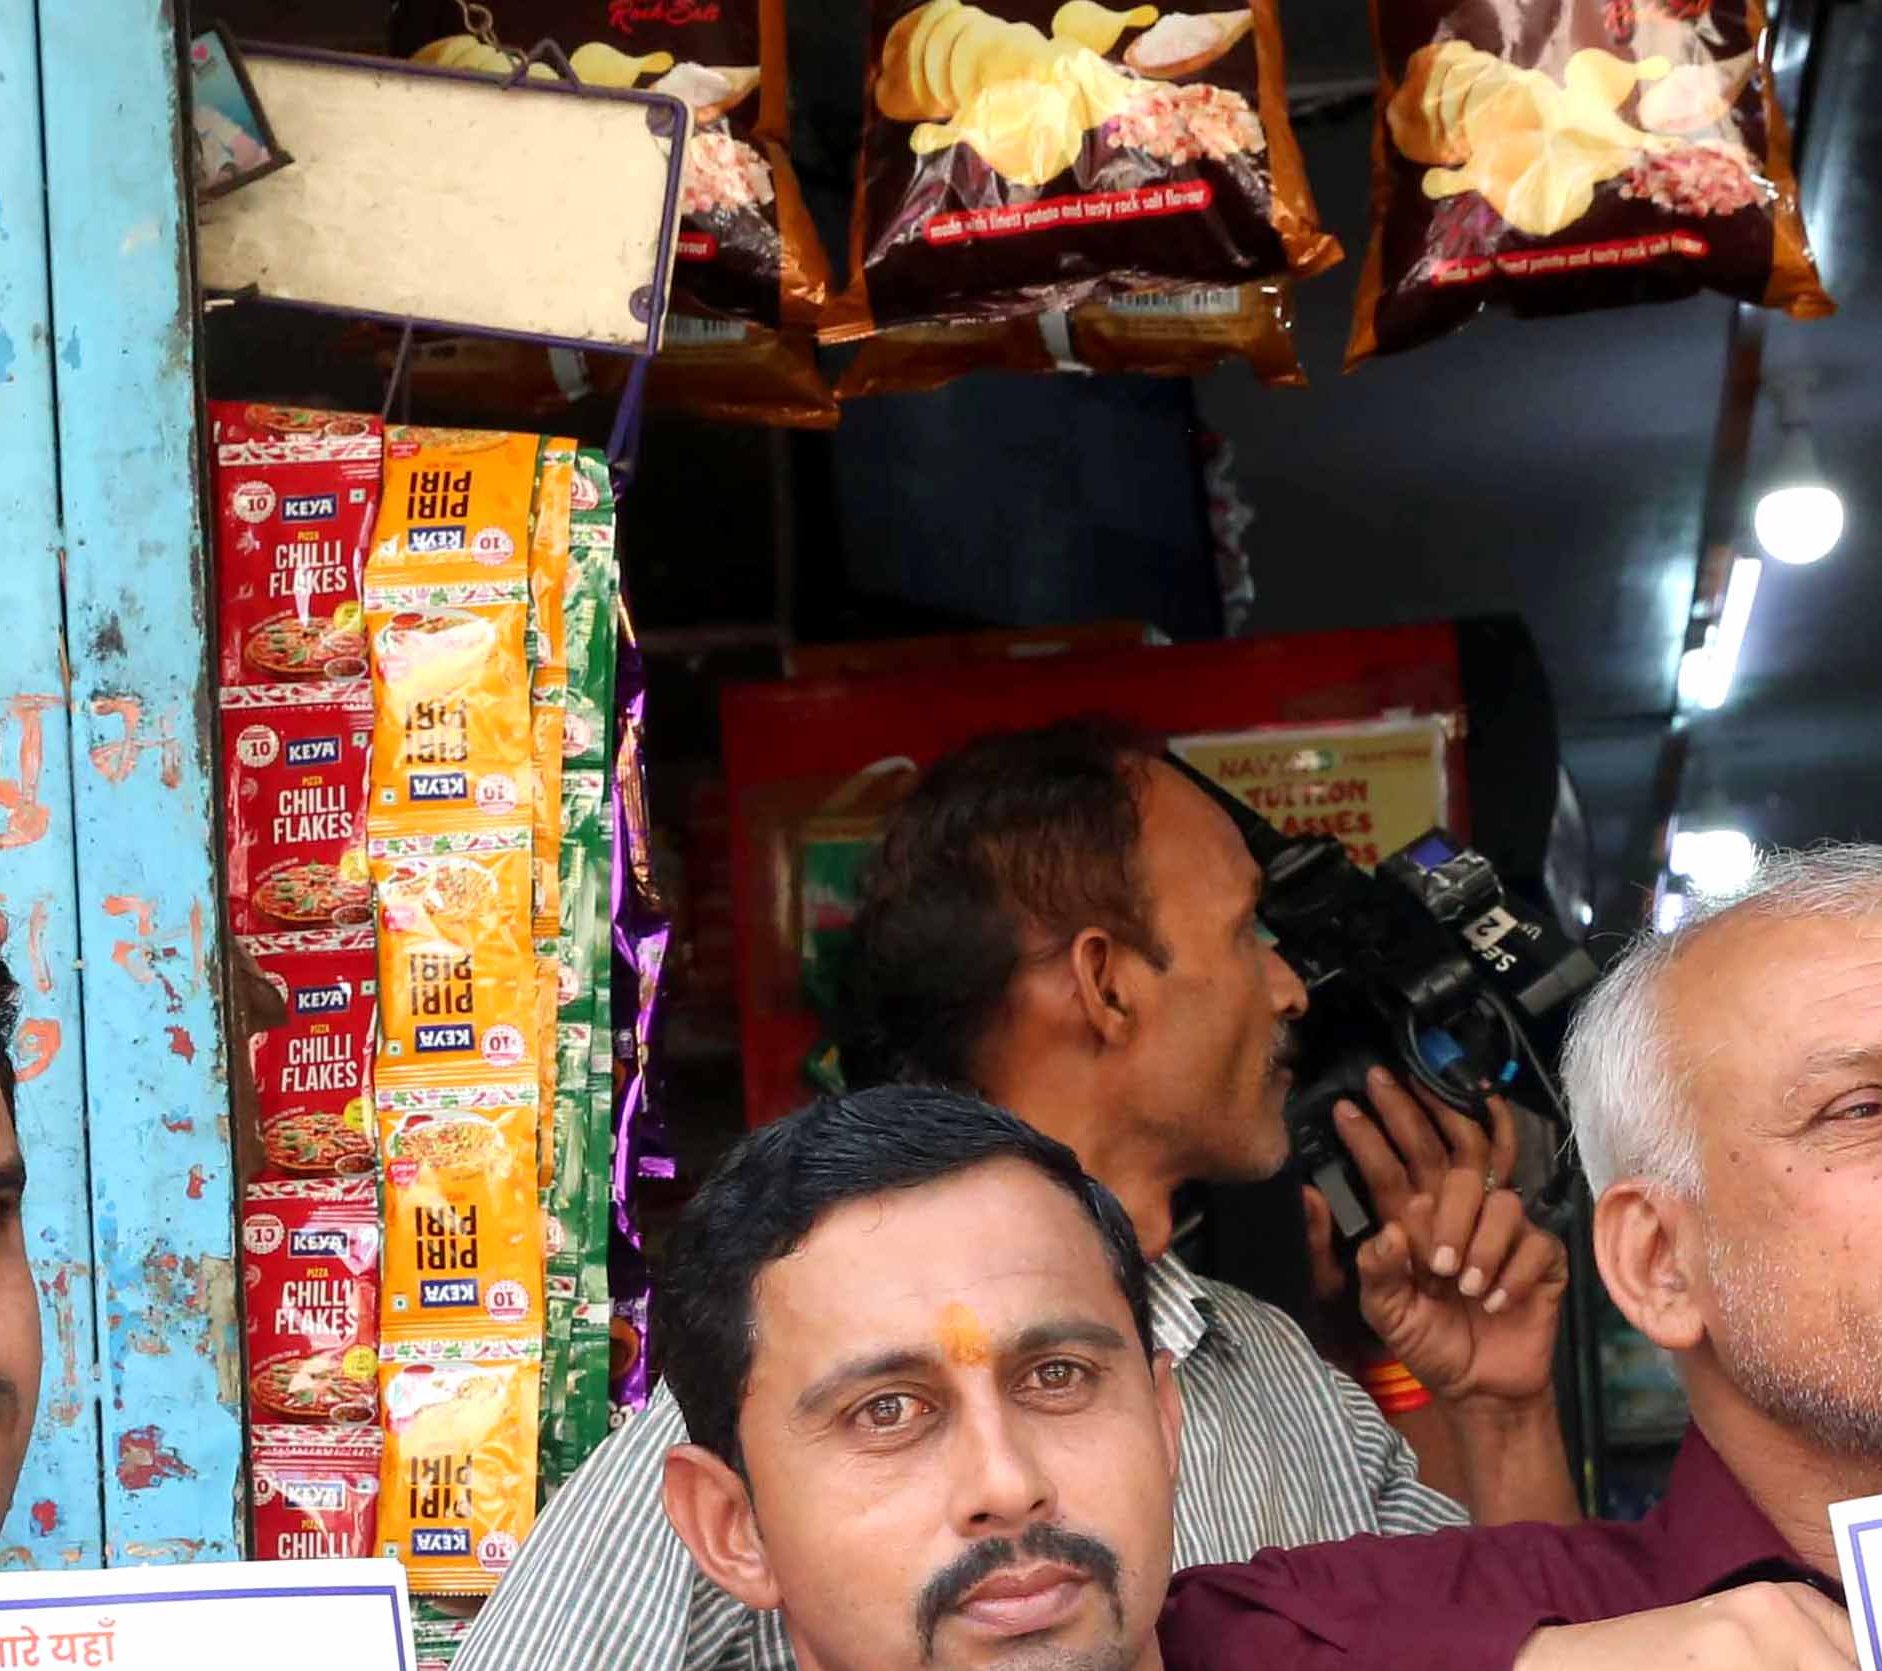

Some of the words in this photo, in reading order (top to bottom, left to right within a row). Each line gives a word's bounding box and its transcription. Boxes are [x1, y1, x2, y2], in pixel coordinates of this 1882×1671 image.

[410, 471, 471, 494] PIRI
[248, 498, 267, 511] 10
[285, 498, 333, 516] KEYA
[407, 495, 468, 520] PIRI
[412, 530, 462, 550] KEYA
[275, 541, 342, 569] CHILLI
[270, 568, 347, 598] FLAKES
[251, 742, 270, 756] 10
[289, 742, 336, 761] KEYA
[414, 777, 464, 796] KEYA
[279, 785, 346, 815] CHILLI
[274, 814, 353, 844] FLAKES
[298, 991, 344, 1008] KEYA
[412, 983, 473, 1016] PIRI
[289, 1034, 351, 1064] CHILLI
[419, 1029, 470, 1048] KEYA
[281, 1062, 357, 1092] FLAKES
[416, 1206, 476, 1237] PIRI
[293, 1236, 344, 1251] KEYA
[417, 1240, 477, 1270] PIRI
[307, 1268, 328, 1278] PIZZA
[282, 1280, 355, 1308] CHILLI
[424, 1284, 476, 1301] KEYA
[494, 1293, 515, 1307] 10
[276, 1308, 358, 1336] FLAKES
[278, 1532, 348, 1558] CHILLI
[417, 1533, 467, 1552] KEYA
[47, 1619, 116, 1665] यहाँ
